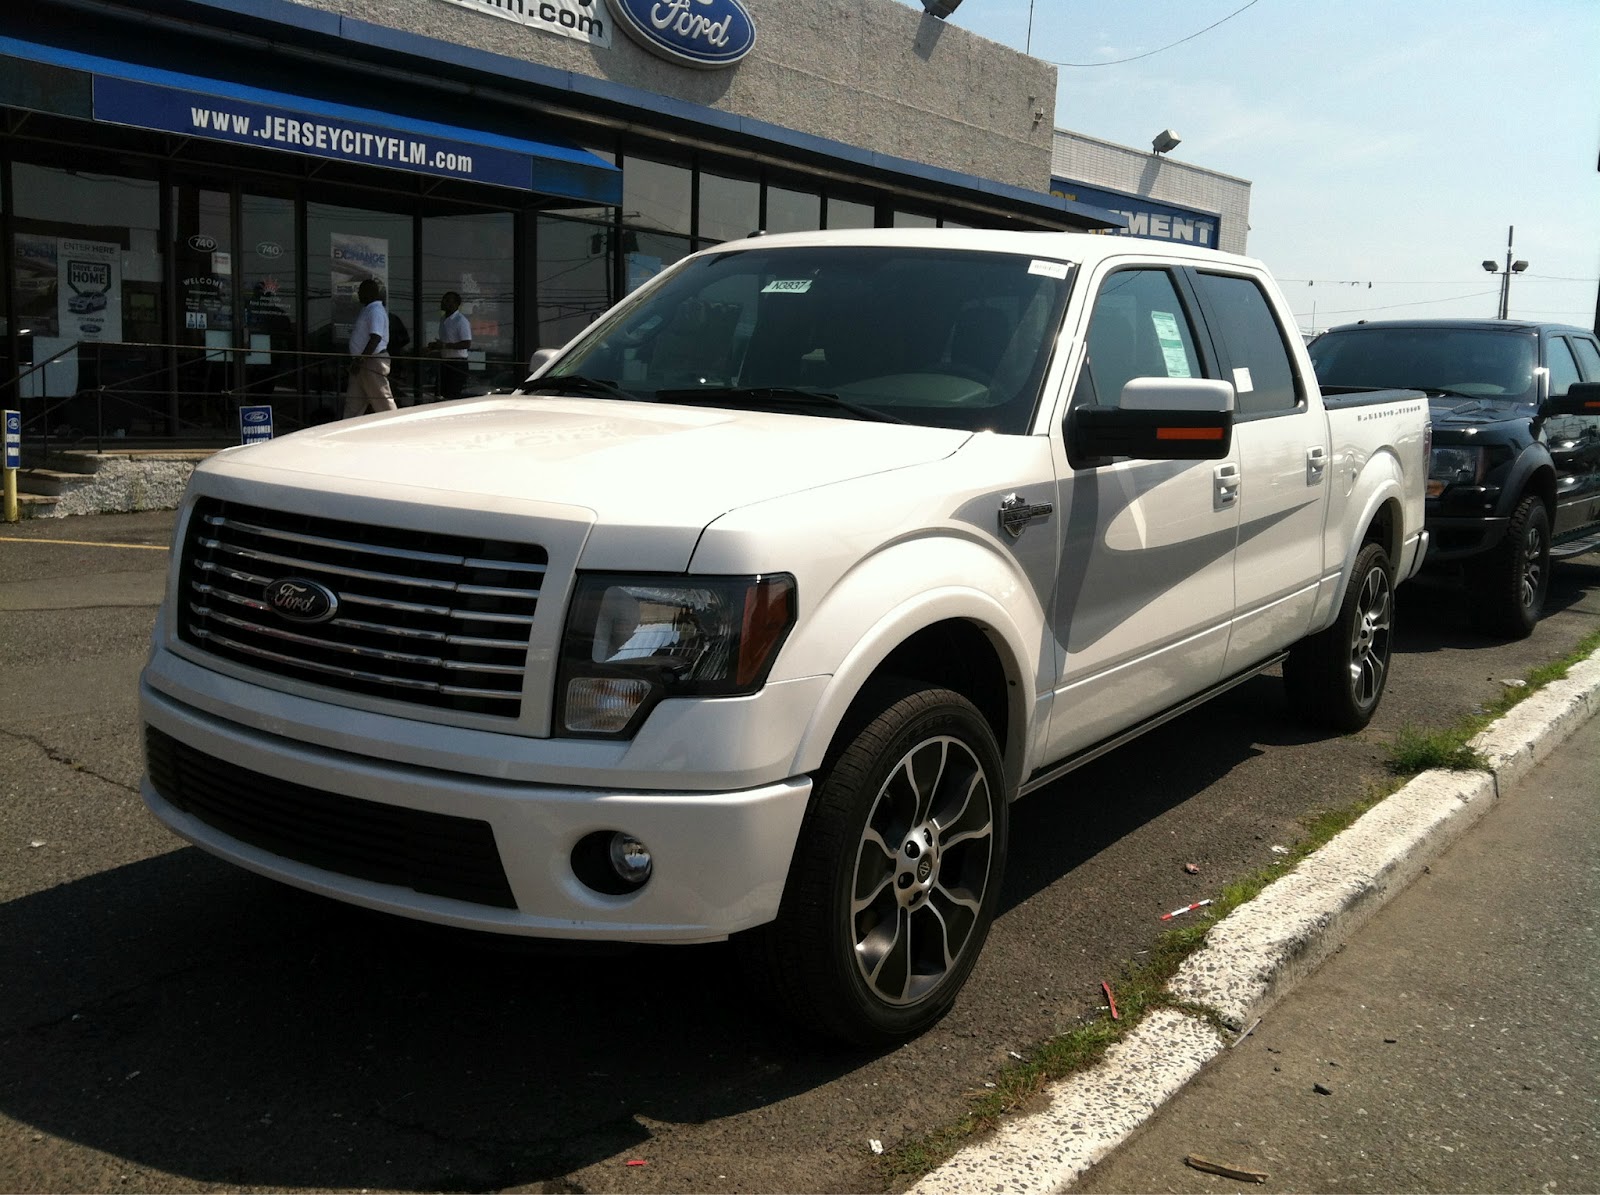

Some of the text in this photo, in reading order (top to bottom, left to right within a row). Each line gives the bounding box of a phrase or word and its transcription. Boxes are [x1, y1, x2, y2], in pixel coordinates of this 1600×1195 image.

[650, 0, 733, 48] Ford
[64, 242, 90, 251] ENTER
[92, 244, 115, 254] HERE
[195, 238, 215, 248] 740
[261, 244, 280, 255] 740
[73, 272, 106, 284] HOME
[183, 277, 223, 289] WELCOME
[772, 282, 806, 290] N3837
[243, 425, 271, 434] CUSTOMER
[274, 582, 317, 613] Ford
